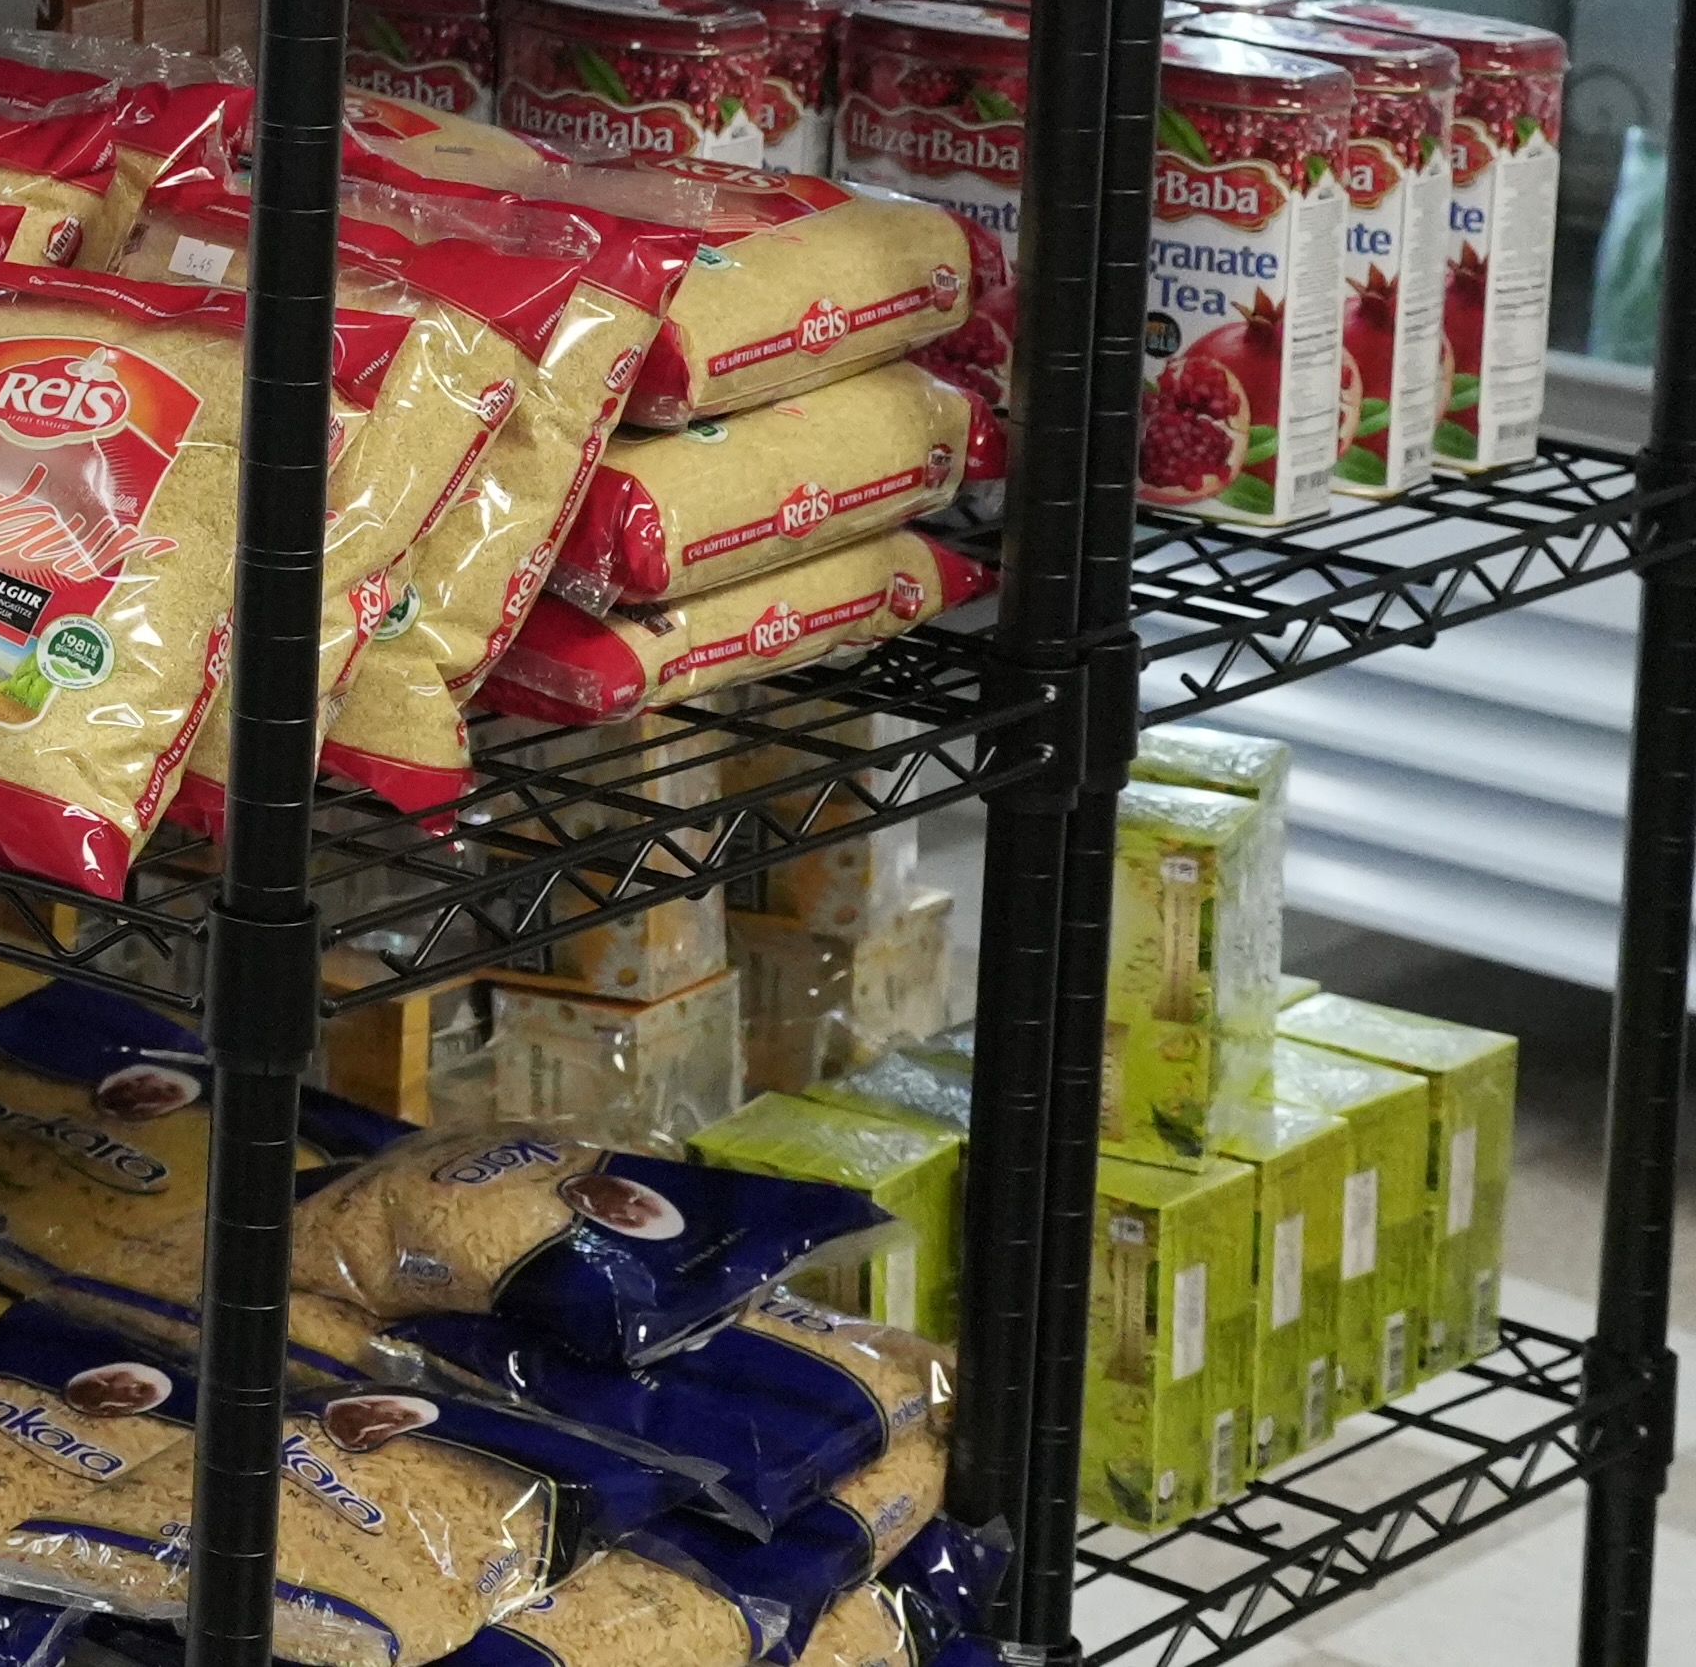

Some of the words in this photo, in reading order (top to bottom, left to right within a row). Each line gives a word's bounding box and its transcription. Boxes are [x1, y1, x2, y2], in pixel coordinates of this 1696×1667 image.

[511, 94, 676, 155] HazerBaba
[851, 112, 1021, 172] HazerBaba
[1155, 274, 1227, 319] Tea
[801, 307, 848, 347] Reis
[741, 521, 775, 543] BULGUR
[783, 494, 832, 532] Reis
[358, 568, 389, 636] Reis
[507, 543, 554, 618] Reis
[707, 640, 744, 661] BULGUR
[755, 614, 802, 651] Reis
[174, 690, 212, 752] BULGUR
[282, 1433, 386, 1530] kara
